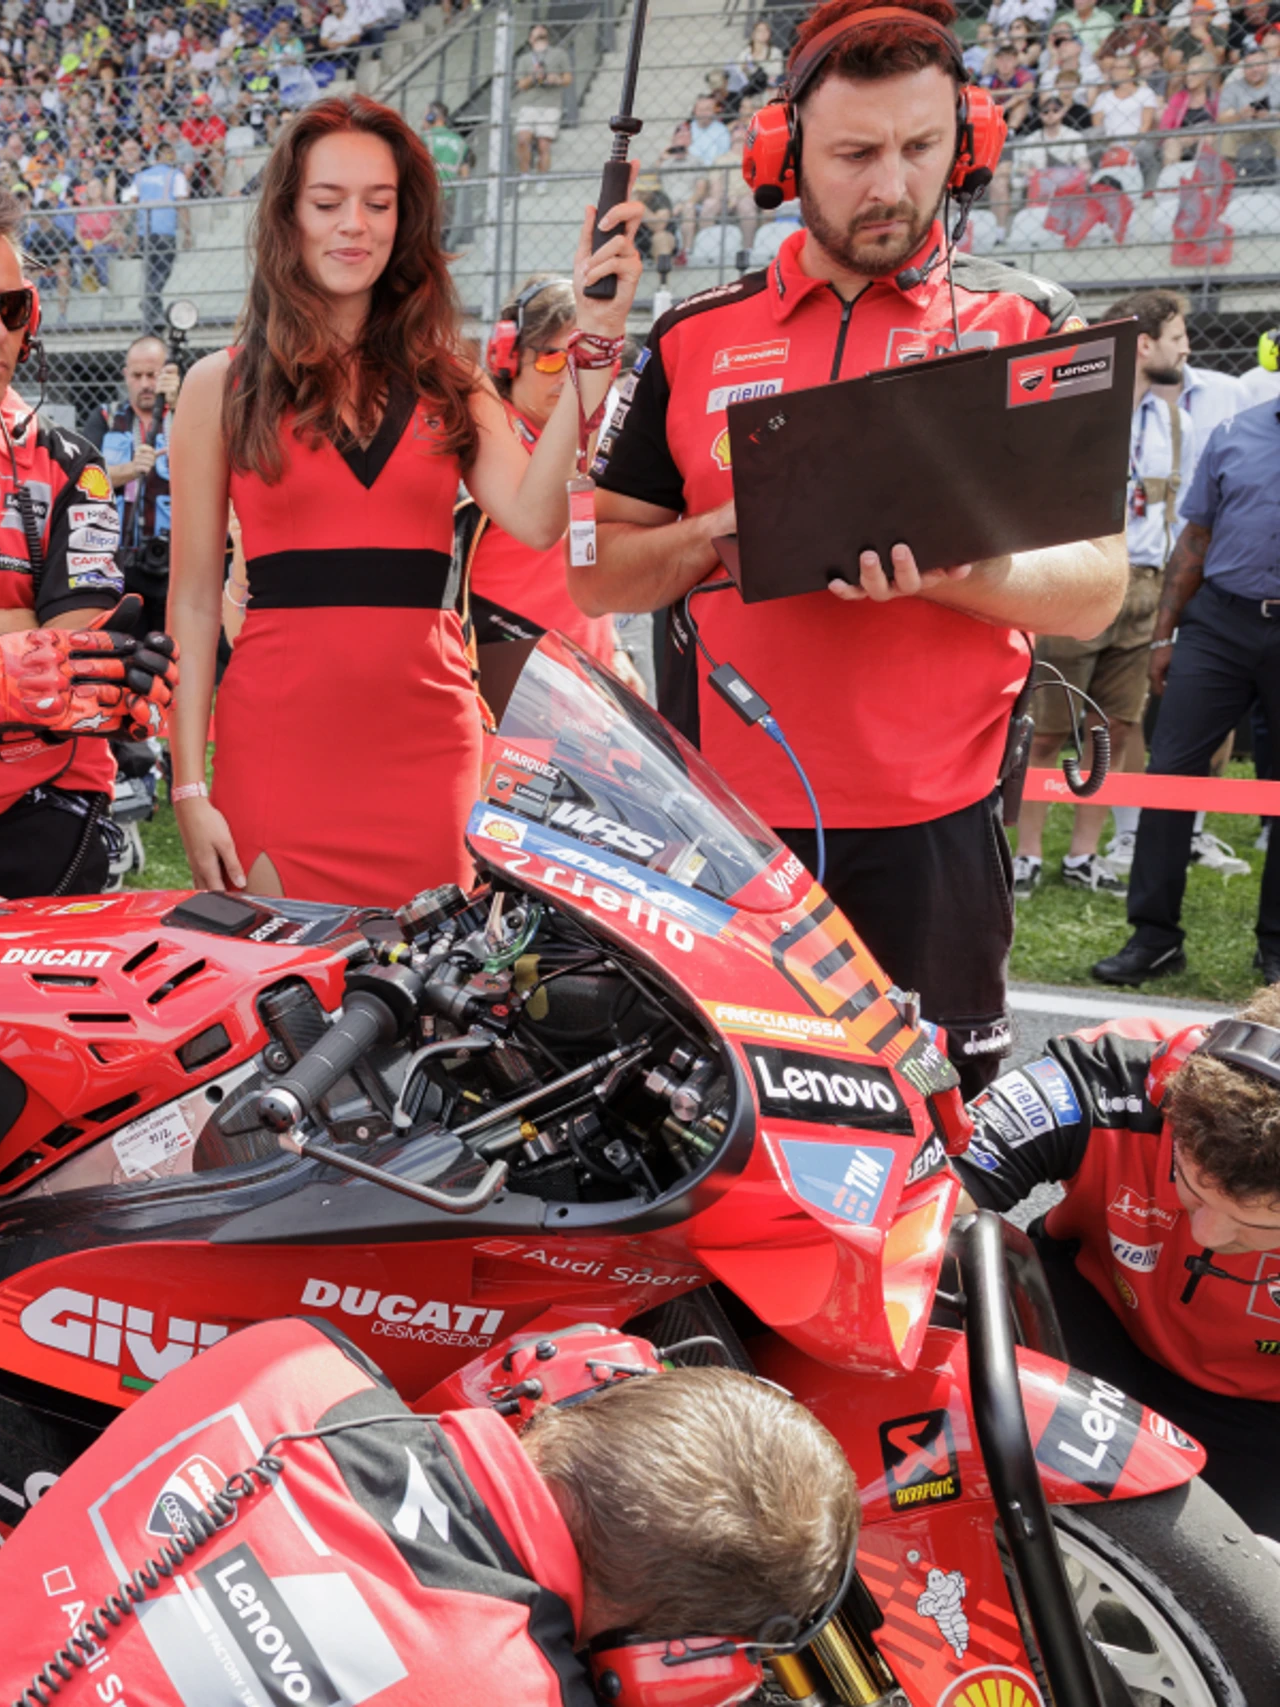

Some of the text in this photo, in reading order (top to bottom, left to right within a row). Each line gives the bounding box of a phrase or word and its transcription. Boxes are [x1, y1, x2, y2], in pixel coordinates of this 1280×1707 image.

[1056, 359, 1107, 379] Lenovo
[501, 748, 561, 780] MARQUEZ
[550, 801, 665, 858] WRS
[542, 866, 695, 953] riello
[1, 948, 113, 969] DUCATI
[714, 1006, 847, 1040] FRECCIAROSSA
[755, 1055, 898, 1113] Lenovo
[1008, 1080, 1047, 1129] riello
[1046, 1075, 1074, 1113] TIM
[843, 1148, 885, 1198] TIM
[523, 1249, 702, 1286] Audi Sport
[1113, 1241, 1158, 1267] riello
[300, 1277, 505, 1336] DUCATI
[370, 1320, 493, 1348] DESMOSEDICI
[1057, 1376, 1126, 1470] Leno
[215, 1558, 312, 1703] Lenovo
[207, 1631, 247, 1688] FACTORY
